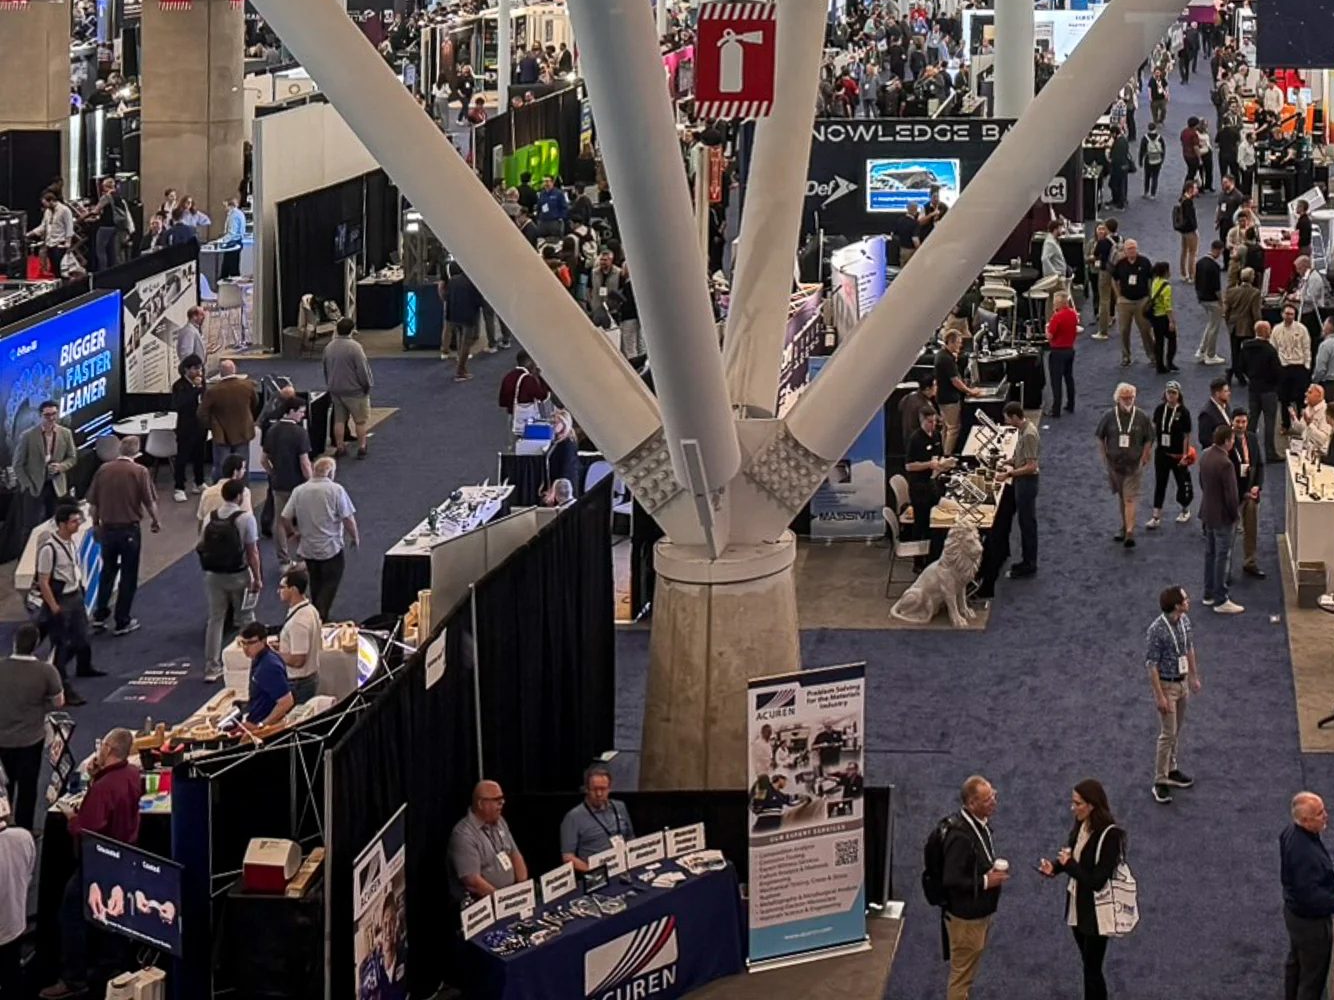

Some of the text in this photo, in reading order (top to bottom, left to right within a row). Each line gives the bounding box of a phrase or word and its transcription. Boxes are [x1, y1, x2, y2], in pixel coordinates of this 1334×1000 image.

[805, 180, 836, 197] Def
[59, 327, 106, 367] BIGGER
[65, 349, 112, 390] FASTER
[58, 376, 107, 419] LEANER
[818, 510, 877, 522] MASSIVIT
[806, 684, 861, 697] Problem Solving
[817, 695, 828, 703] the
[829, 691, 860, 701] Materials
[756, 708, 796, 721] ACUREN
[591, 965, 678, 1000] CUREN
